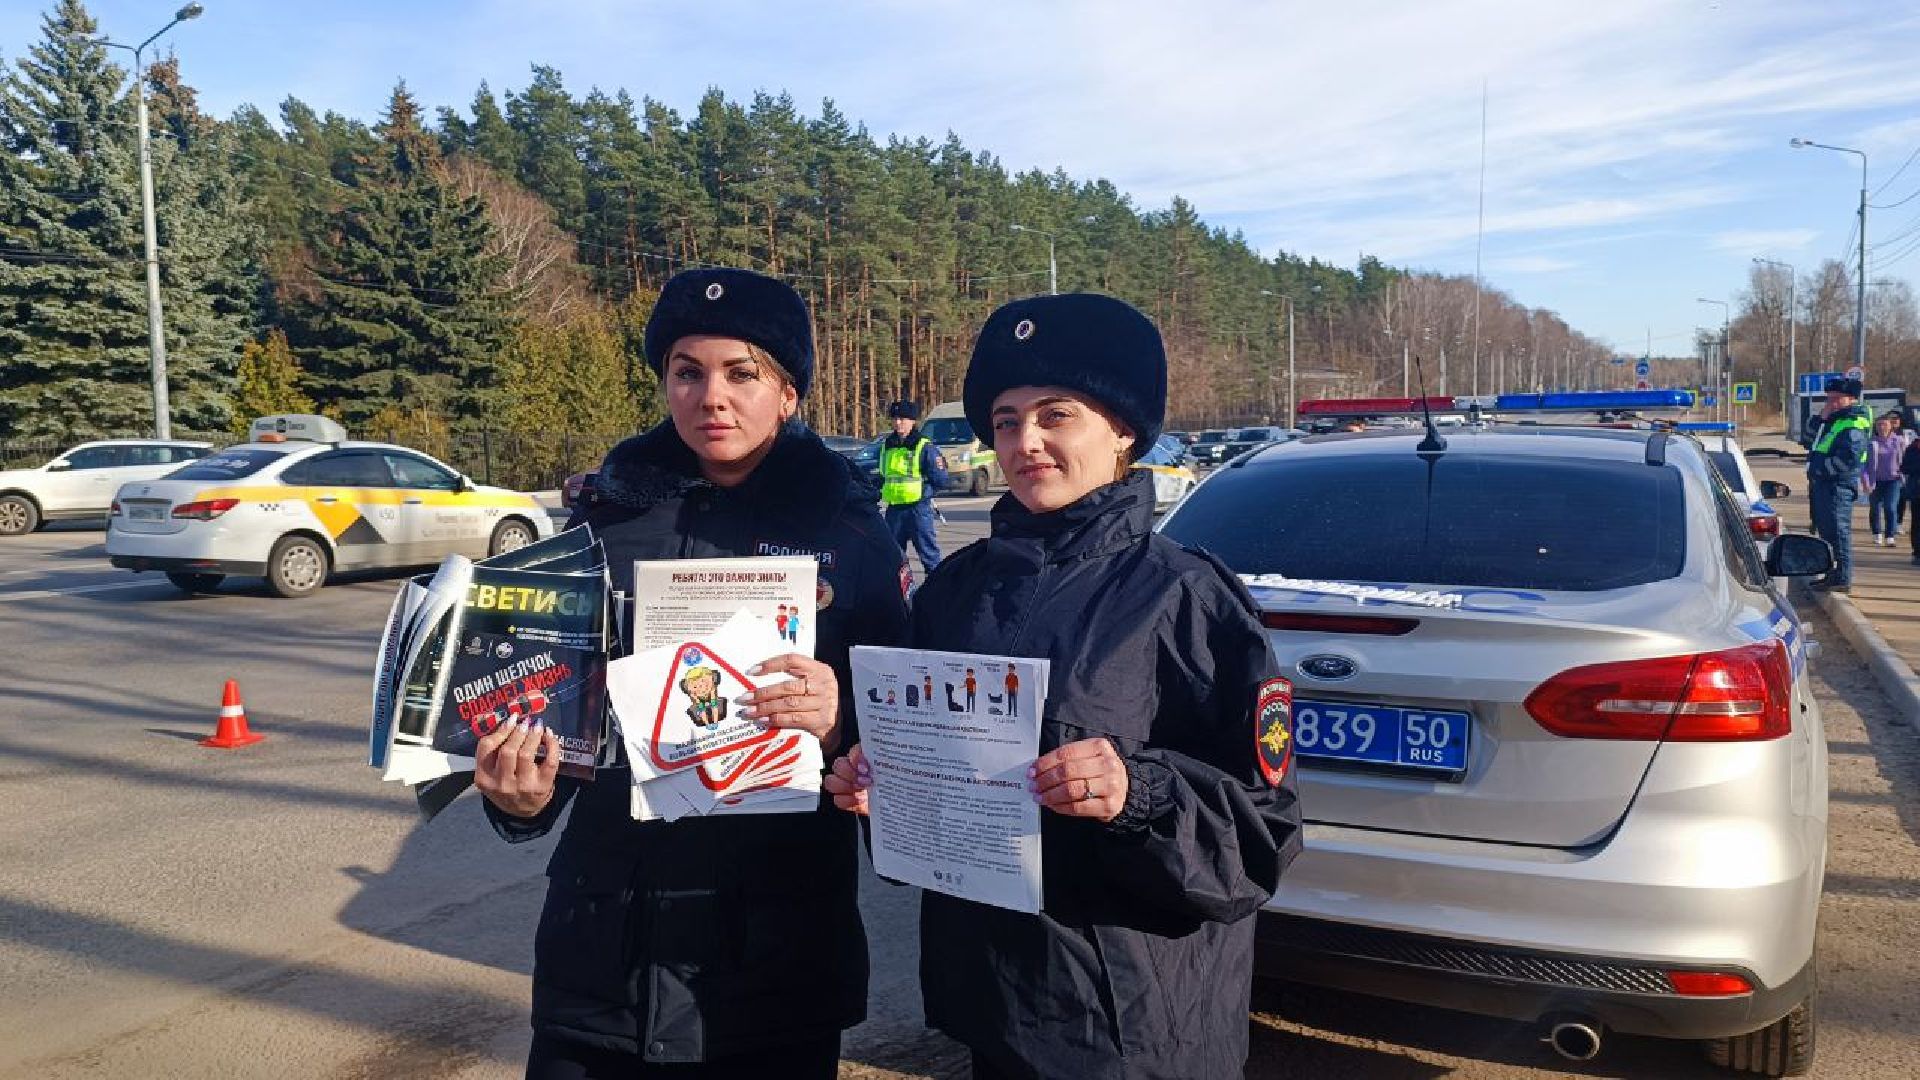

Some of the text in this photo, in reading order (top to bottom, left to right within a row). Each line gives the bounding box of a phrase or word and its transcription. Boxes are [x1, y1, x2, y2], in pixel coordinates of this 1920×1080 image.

[453, 650, 556, 703] ОДИН ЩЕЛЧОК
[459, 663, 573, 720] СПАСАЕТ ЖИЗНЬ
[1295, 708, 1450, 753] 839 50
[1410, 748, 1443, 763] RUS
